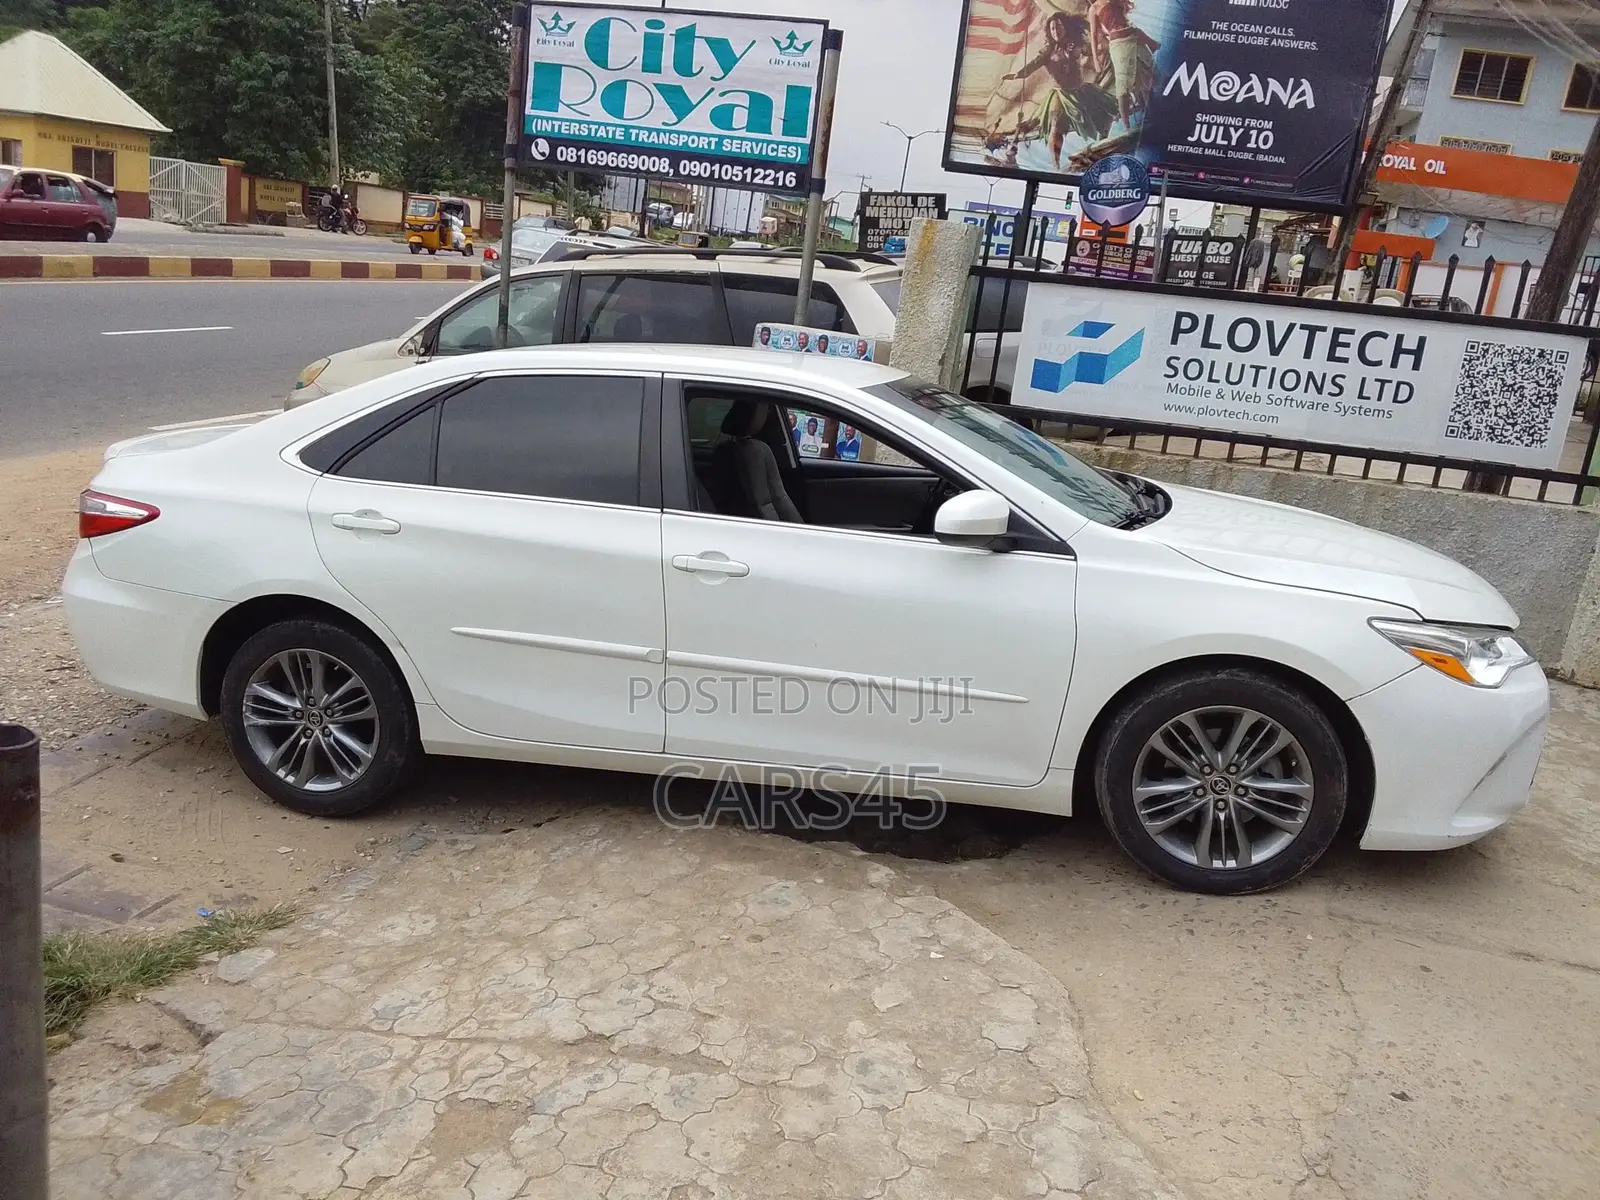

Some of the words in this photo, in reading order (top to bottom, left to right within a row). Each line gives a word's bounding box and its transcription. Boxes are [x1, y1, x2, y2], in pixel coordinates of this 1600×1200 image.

[1211, 21, 1229, 31] THE
[1231, 23, 1263, 34] OCEAN
[1265, 26, 1296, 37] CALLS.
[584, 17, 756, 81] City
[1184, 30, 1237, 43] FILMHOUSE
[1237, 35, 1270, 46] DUGBE
[1270, 39, 1319, 51] ANSWERS.
[1163, 60, 1316, 109] MOANA
[530, 61, 812, 138] Royal
[1195, 113, 1243, 126] SHOWING
[1244, 118, 1273, 129] FROM
[532, 118, 625, 140] (INTERSTATE
[629, 129, 719, 150] TRANSPORT
[722, 139, 802, 162] SERVICES)
[1187, 123, 1244, 146] JULY
[1246, 129, 1274, 150] 10
[1167, 144, 1203, 155] HERITAGE
[1204, 148, 1226, 158] MALL,
[1256, 154, 1287, 164] IBADAN.
[1379, 154, 1417, 171] OYAL
[1424, 159, 1447, 175] OIL
[556, 146, 674, 177] 08169669008,
[680, 160, 797, 188] 09010512216
[869, 195, 914, 207] FAKOL
[917, 196, 936, 208] DE
[1088, 188, 1141, 201] GOLDBERG
[865, 206, 939, 219] MERIDIAN
[879, 218, 912, 229] MOT
[1203, 255, 1231, 264] OUSE
[1178, 270, 1215, 280] LOUGE
[1170, 310, 1428, 372] PLOVTECH
[1163, 355, 1347, 398] SOLUTIONS
[1357, 376, 1415, 405] LTD
[1166, 382, 1212, 399] Mobile
[1215, 387, 1227, 401] &
[1230, 389, 1262, 404] Web
[1265, 393, 1330, 412] Software
[1334, 401, 1394, 420] Systems
[1163, 402, 1280, 424] www.plovtech.com
